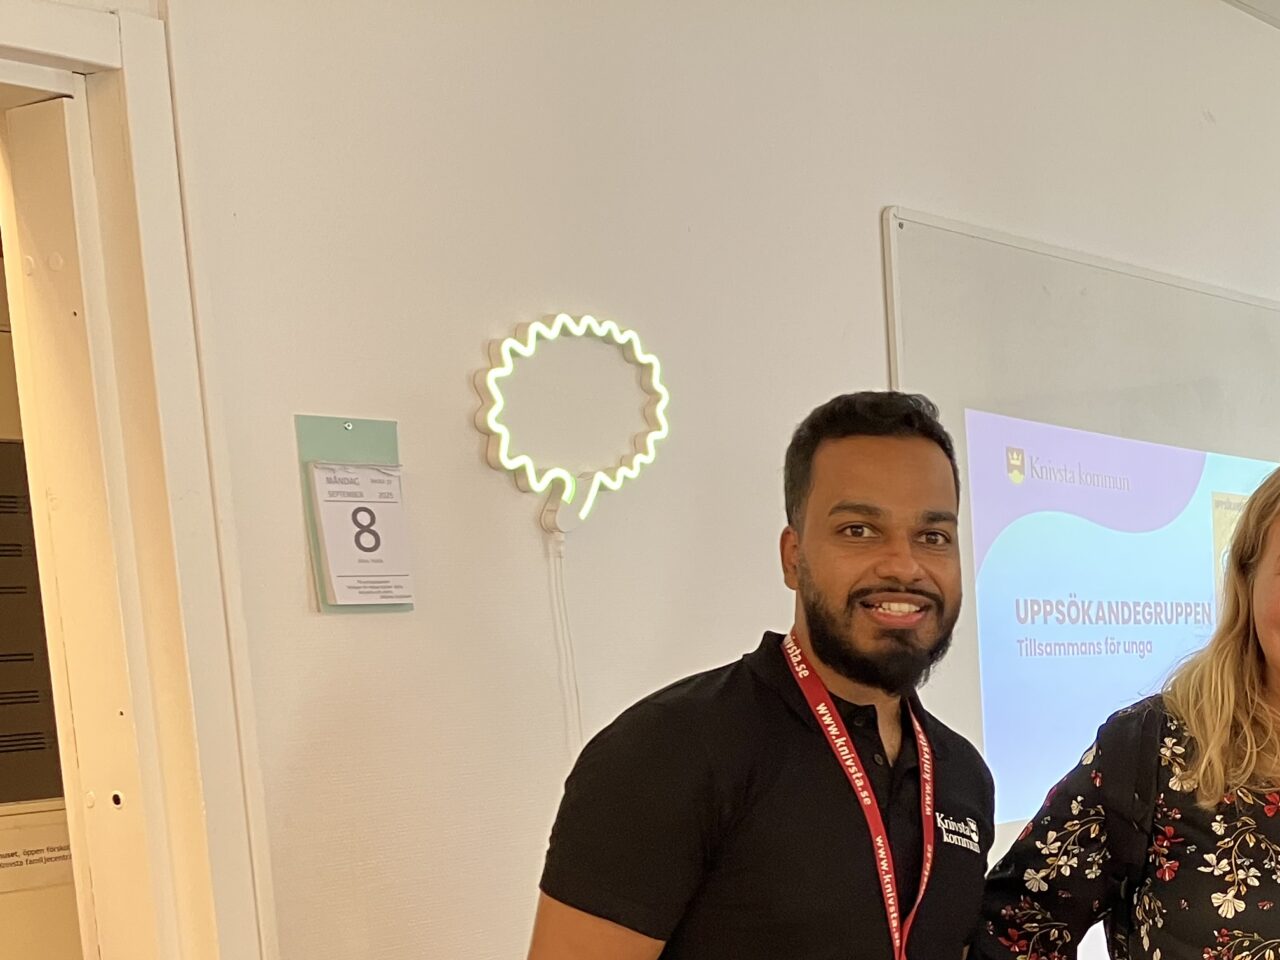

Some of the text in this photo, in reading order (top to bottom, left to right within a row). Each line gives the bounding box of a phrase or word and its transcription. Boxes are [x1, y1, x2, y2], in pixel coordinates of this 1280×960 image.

[1029, 456, 1131, 491] Knivsta kommun
[327, 490, 364, 499] SEPTEMBER
[351, 506, 381, 553] 8
[1015, 592, 1213, 625] UPPSÖKANDEGRUPPEN
[1016, 637, 1153, 660] Tillsammans för unga
[815, 702, 871, 806] www.knivsta.se
[935, 812, 970, 836] Knivsta
[941, 826, 981, 853] kommun
